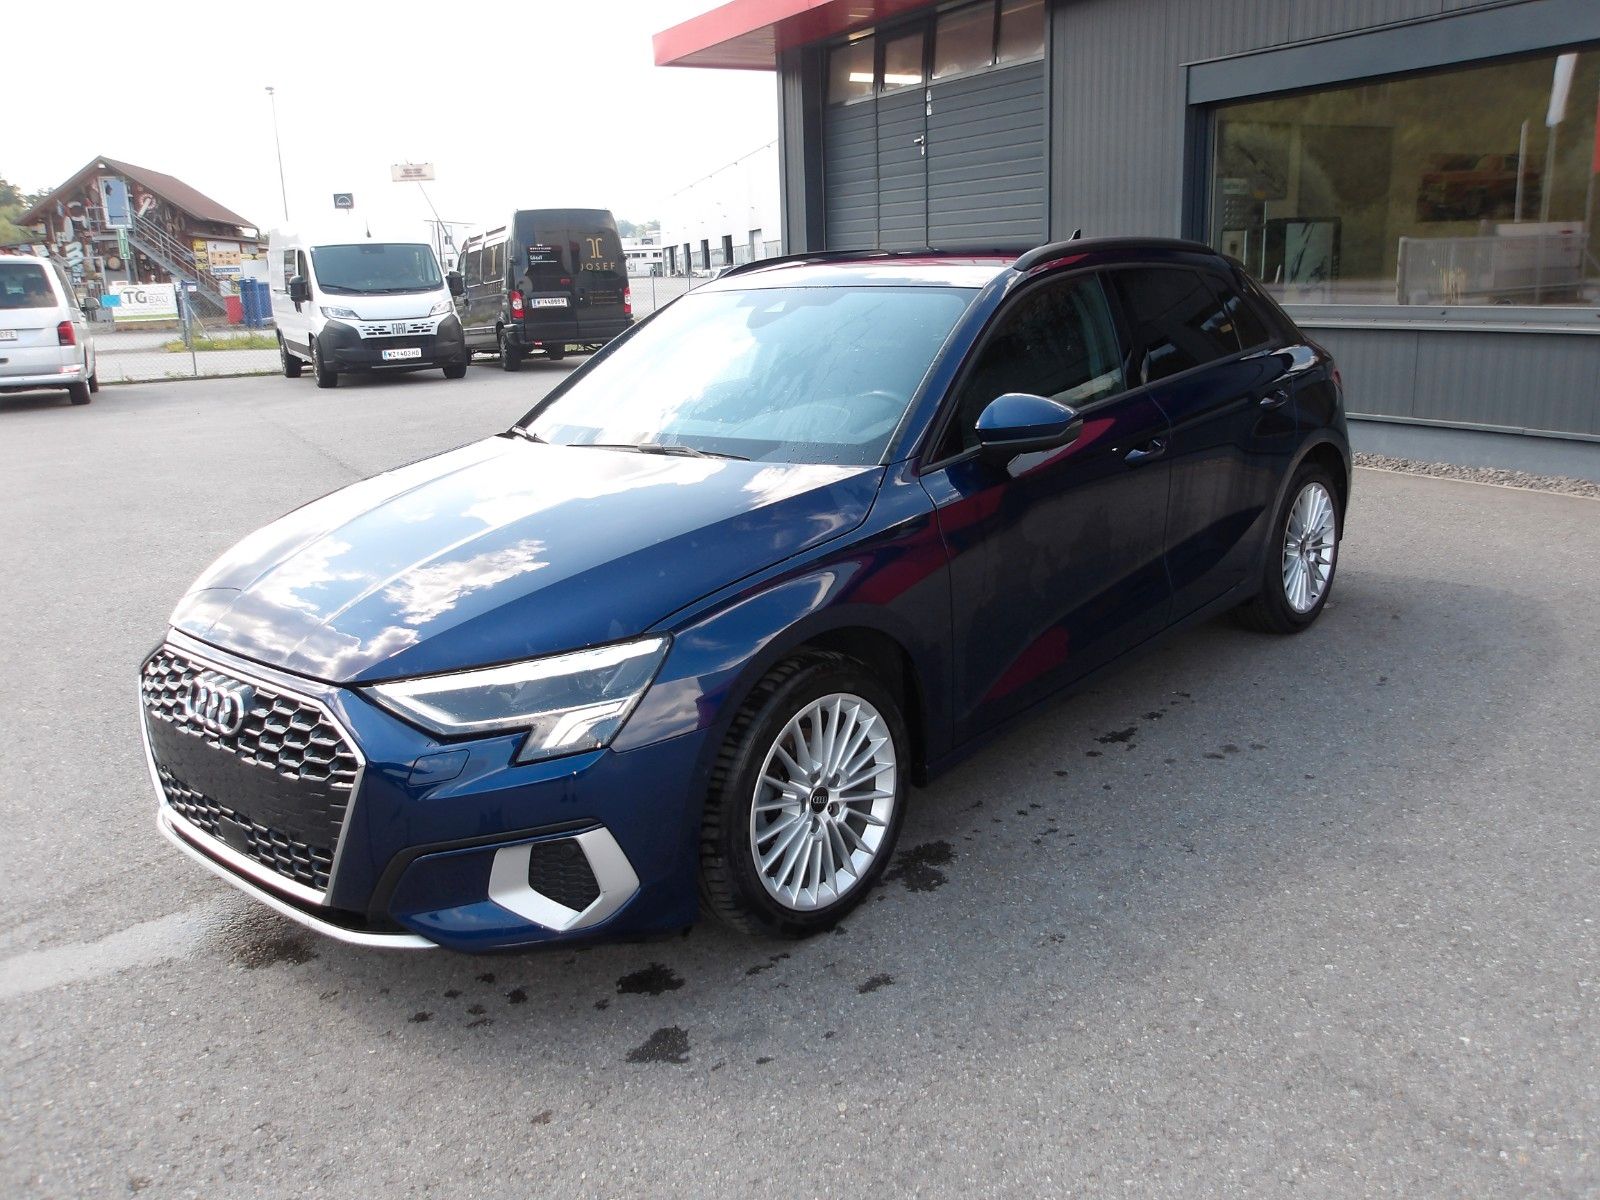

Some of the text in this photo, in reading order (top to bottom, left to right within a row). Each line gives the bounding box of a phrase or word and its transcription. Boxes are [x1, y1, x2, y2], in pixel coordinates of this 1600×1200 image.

[581, 262, 616, 271] JOSEF
[123, 290, 147, 304] TG
[391, 323, 406, 334] FIAT
